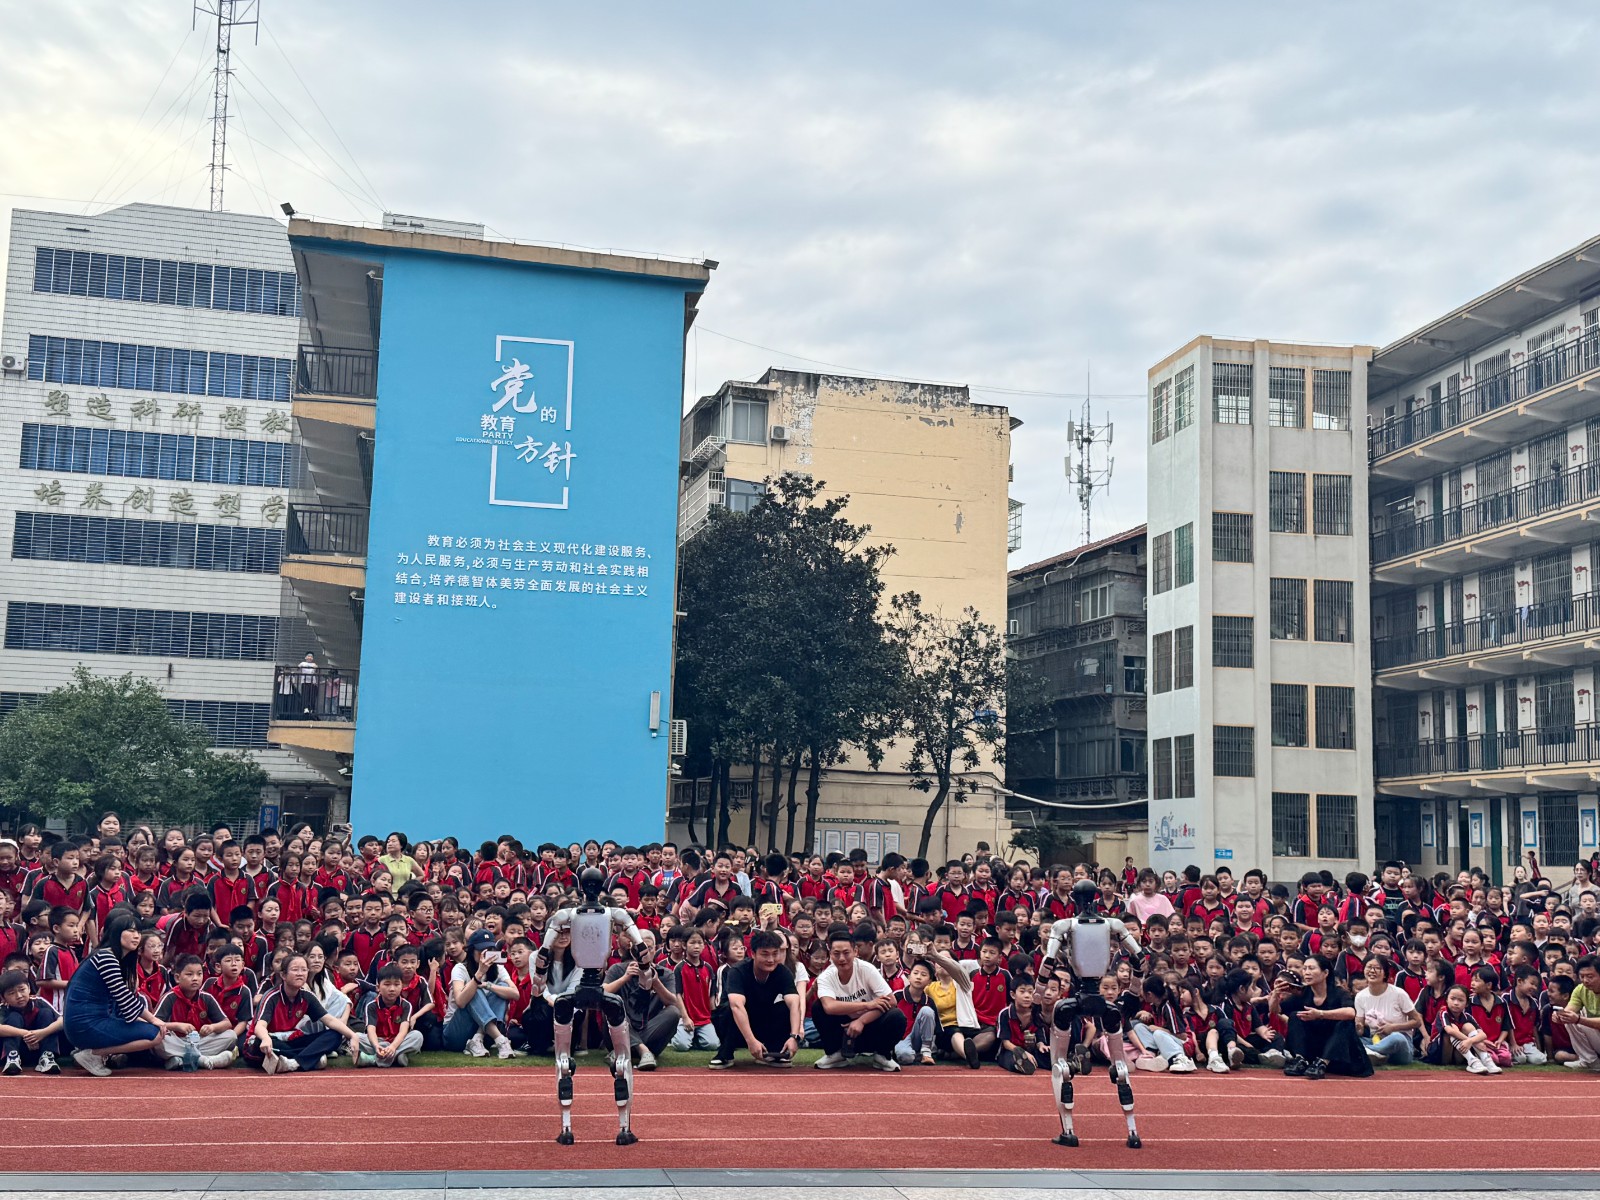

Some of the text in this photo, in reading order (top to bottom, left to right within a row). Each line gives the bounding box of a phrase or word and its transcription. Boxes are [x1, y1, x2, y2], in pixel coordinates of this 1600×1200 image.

[490, 357, 538, 413] 党
[480, 413, 517, 432] 教育
[540, 406, 557, 423] 的
[456, 437, 492, 445] EDUCATIONAL
[482, 431, 513, 439] PARTY
[34, 480, 286, 523] 培养创造型学
[394, 591, 498, 609] 建设者和接班人。
